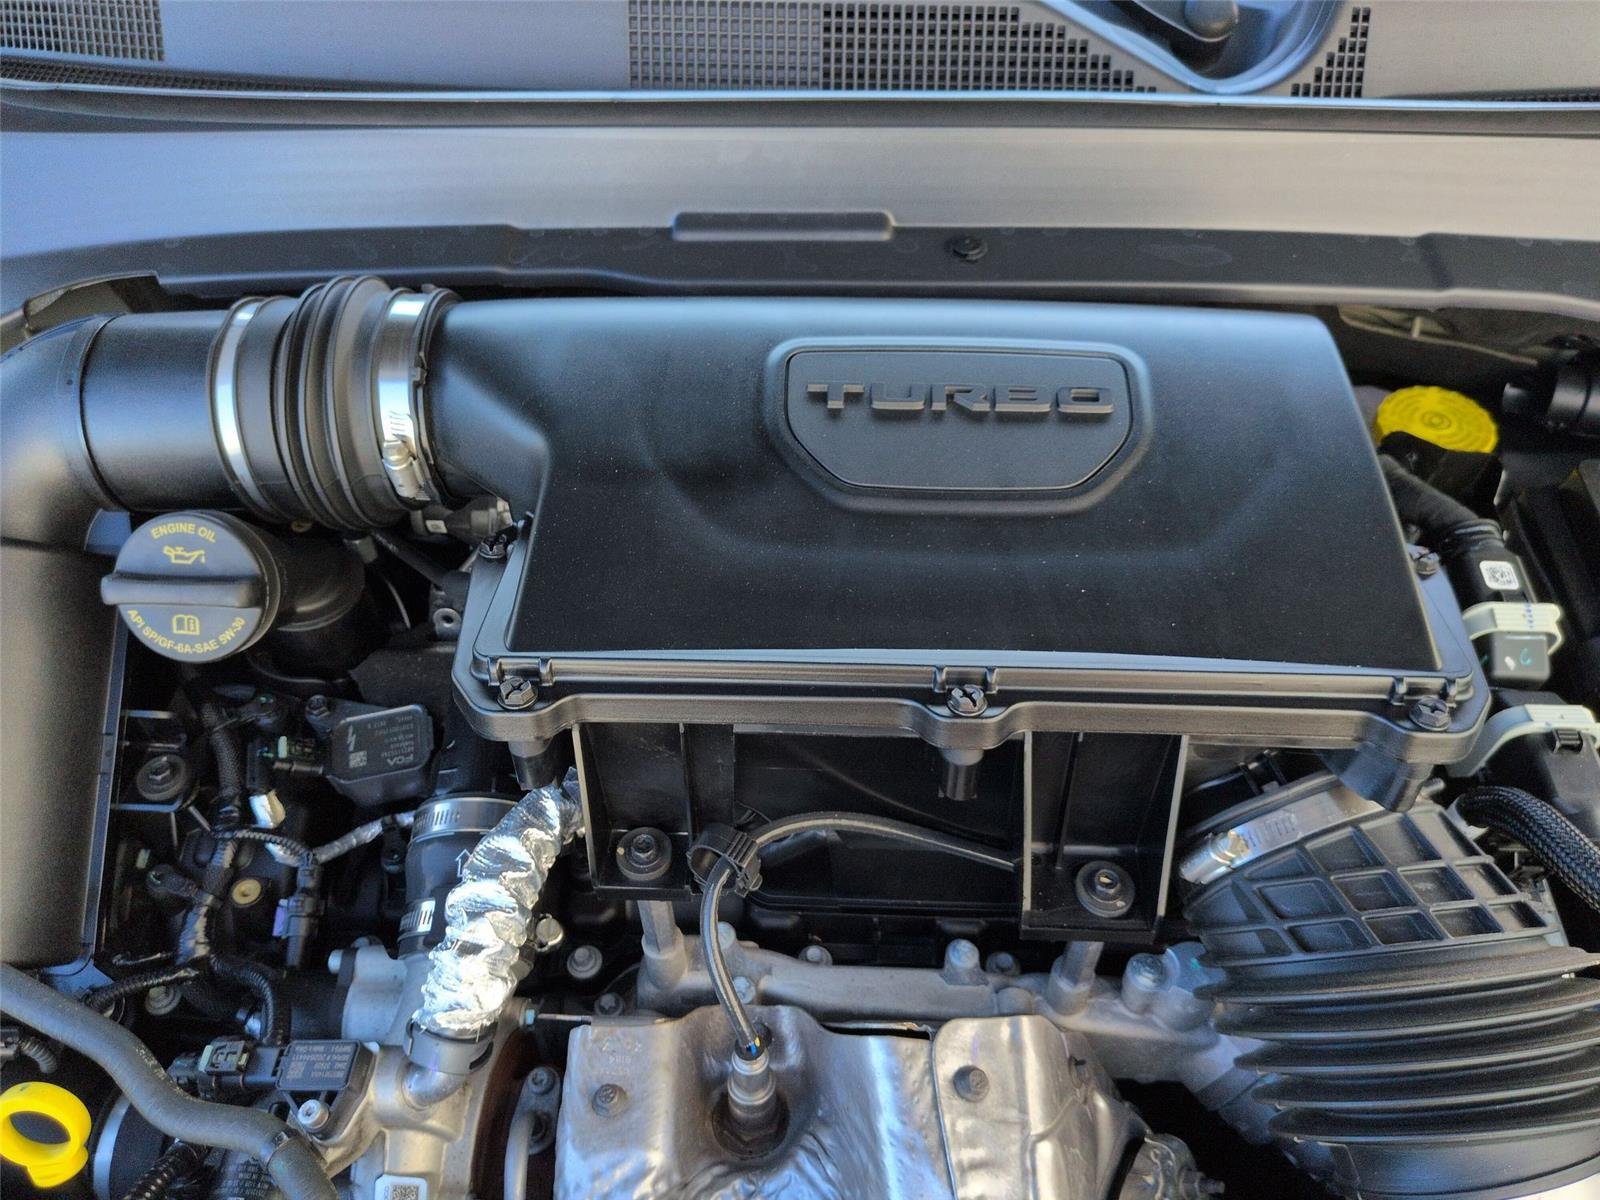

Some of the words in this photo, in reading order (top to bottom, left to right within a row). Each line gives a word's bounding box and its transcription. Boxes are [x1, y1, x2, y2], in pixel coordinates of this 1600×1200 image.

[806, 382, 1114, 413] TURBO
[151, 523, 196, 539] ENGINE
[198, 526, 217, 542] OIL
[127, 609, 144, 628] API
[218, 617, 245, 645] 5W-30
